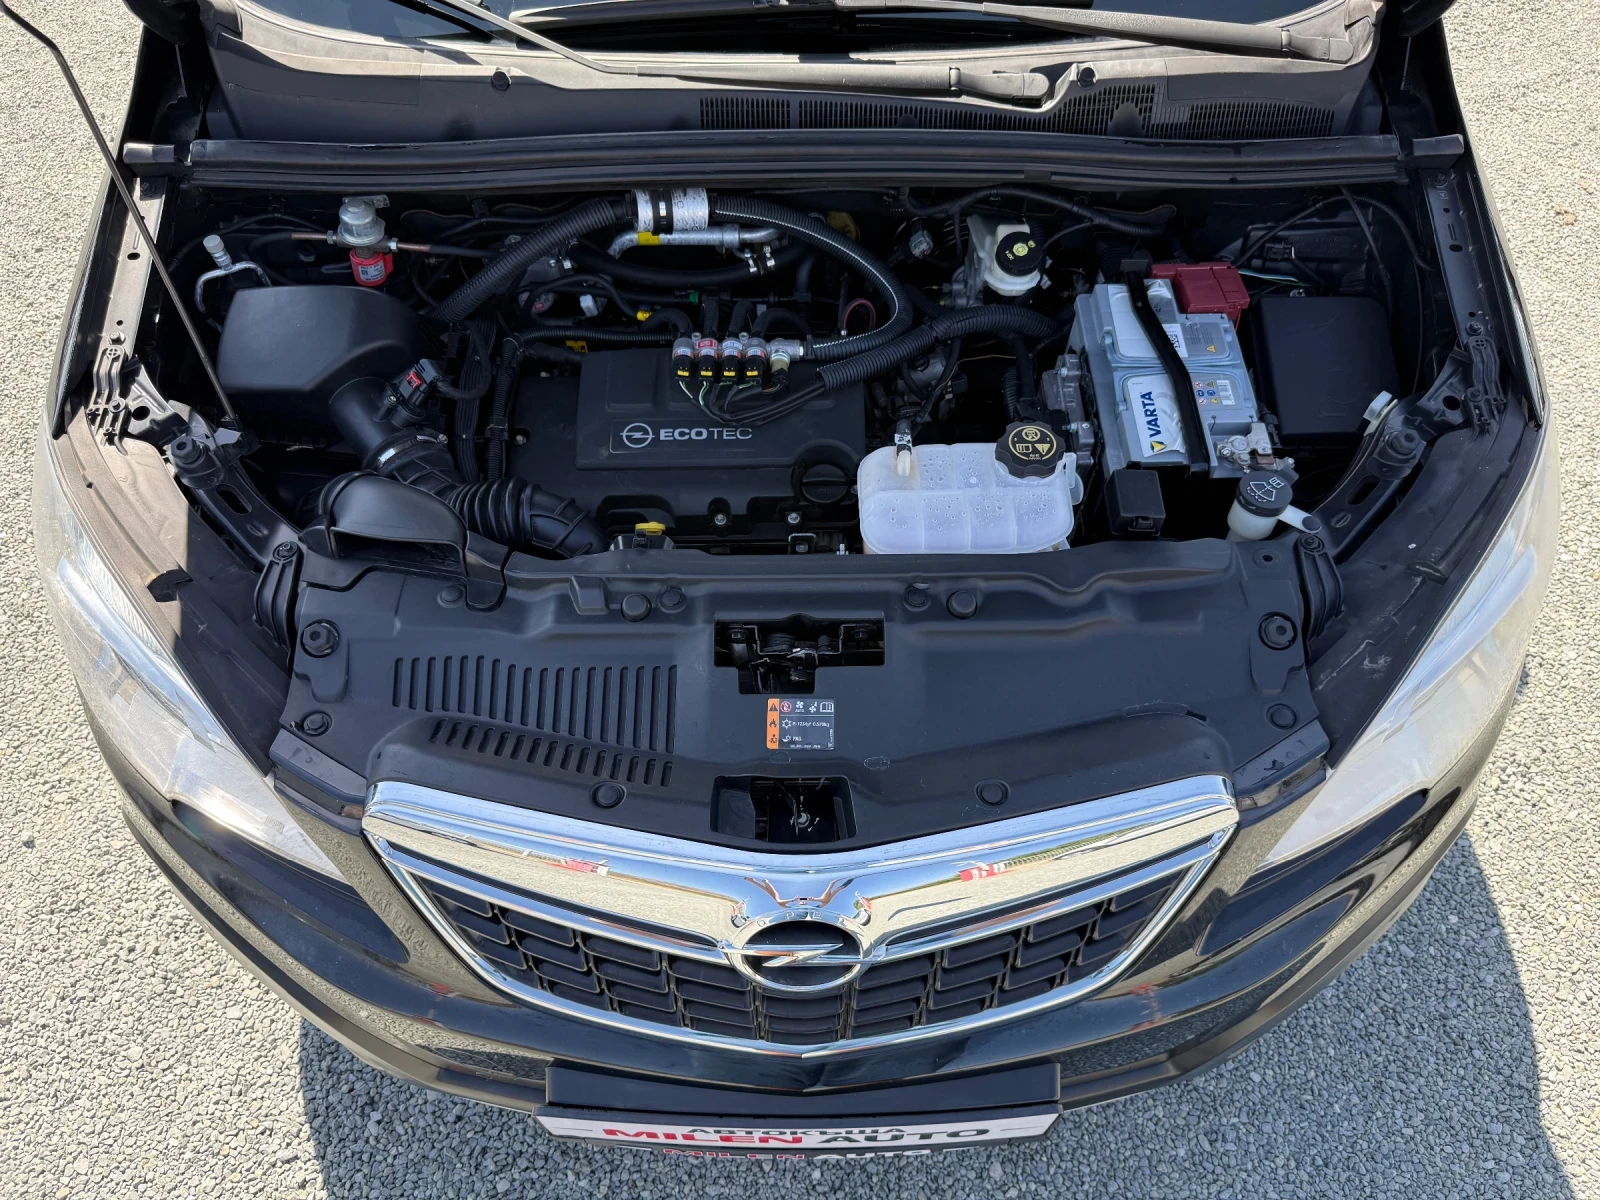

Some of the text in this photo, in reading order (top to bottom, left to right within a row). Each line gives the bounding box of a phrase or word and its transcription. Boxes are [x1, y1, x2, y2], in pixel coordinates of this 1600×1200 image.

[1140, 391, 1162, 438] VARTA
[659, 427, 753, 441] ECOTEC
[756, 911, 848, 927] OPEL
[602, 1128, 990, 1144] MILEN AUTO
[663, 1148, 804, 1160] MILEN
